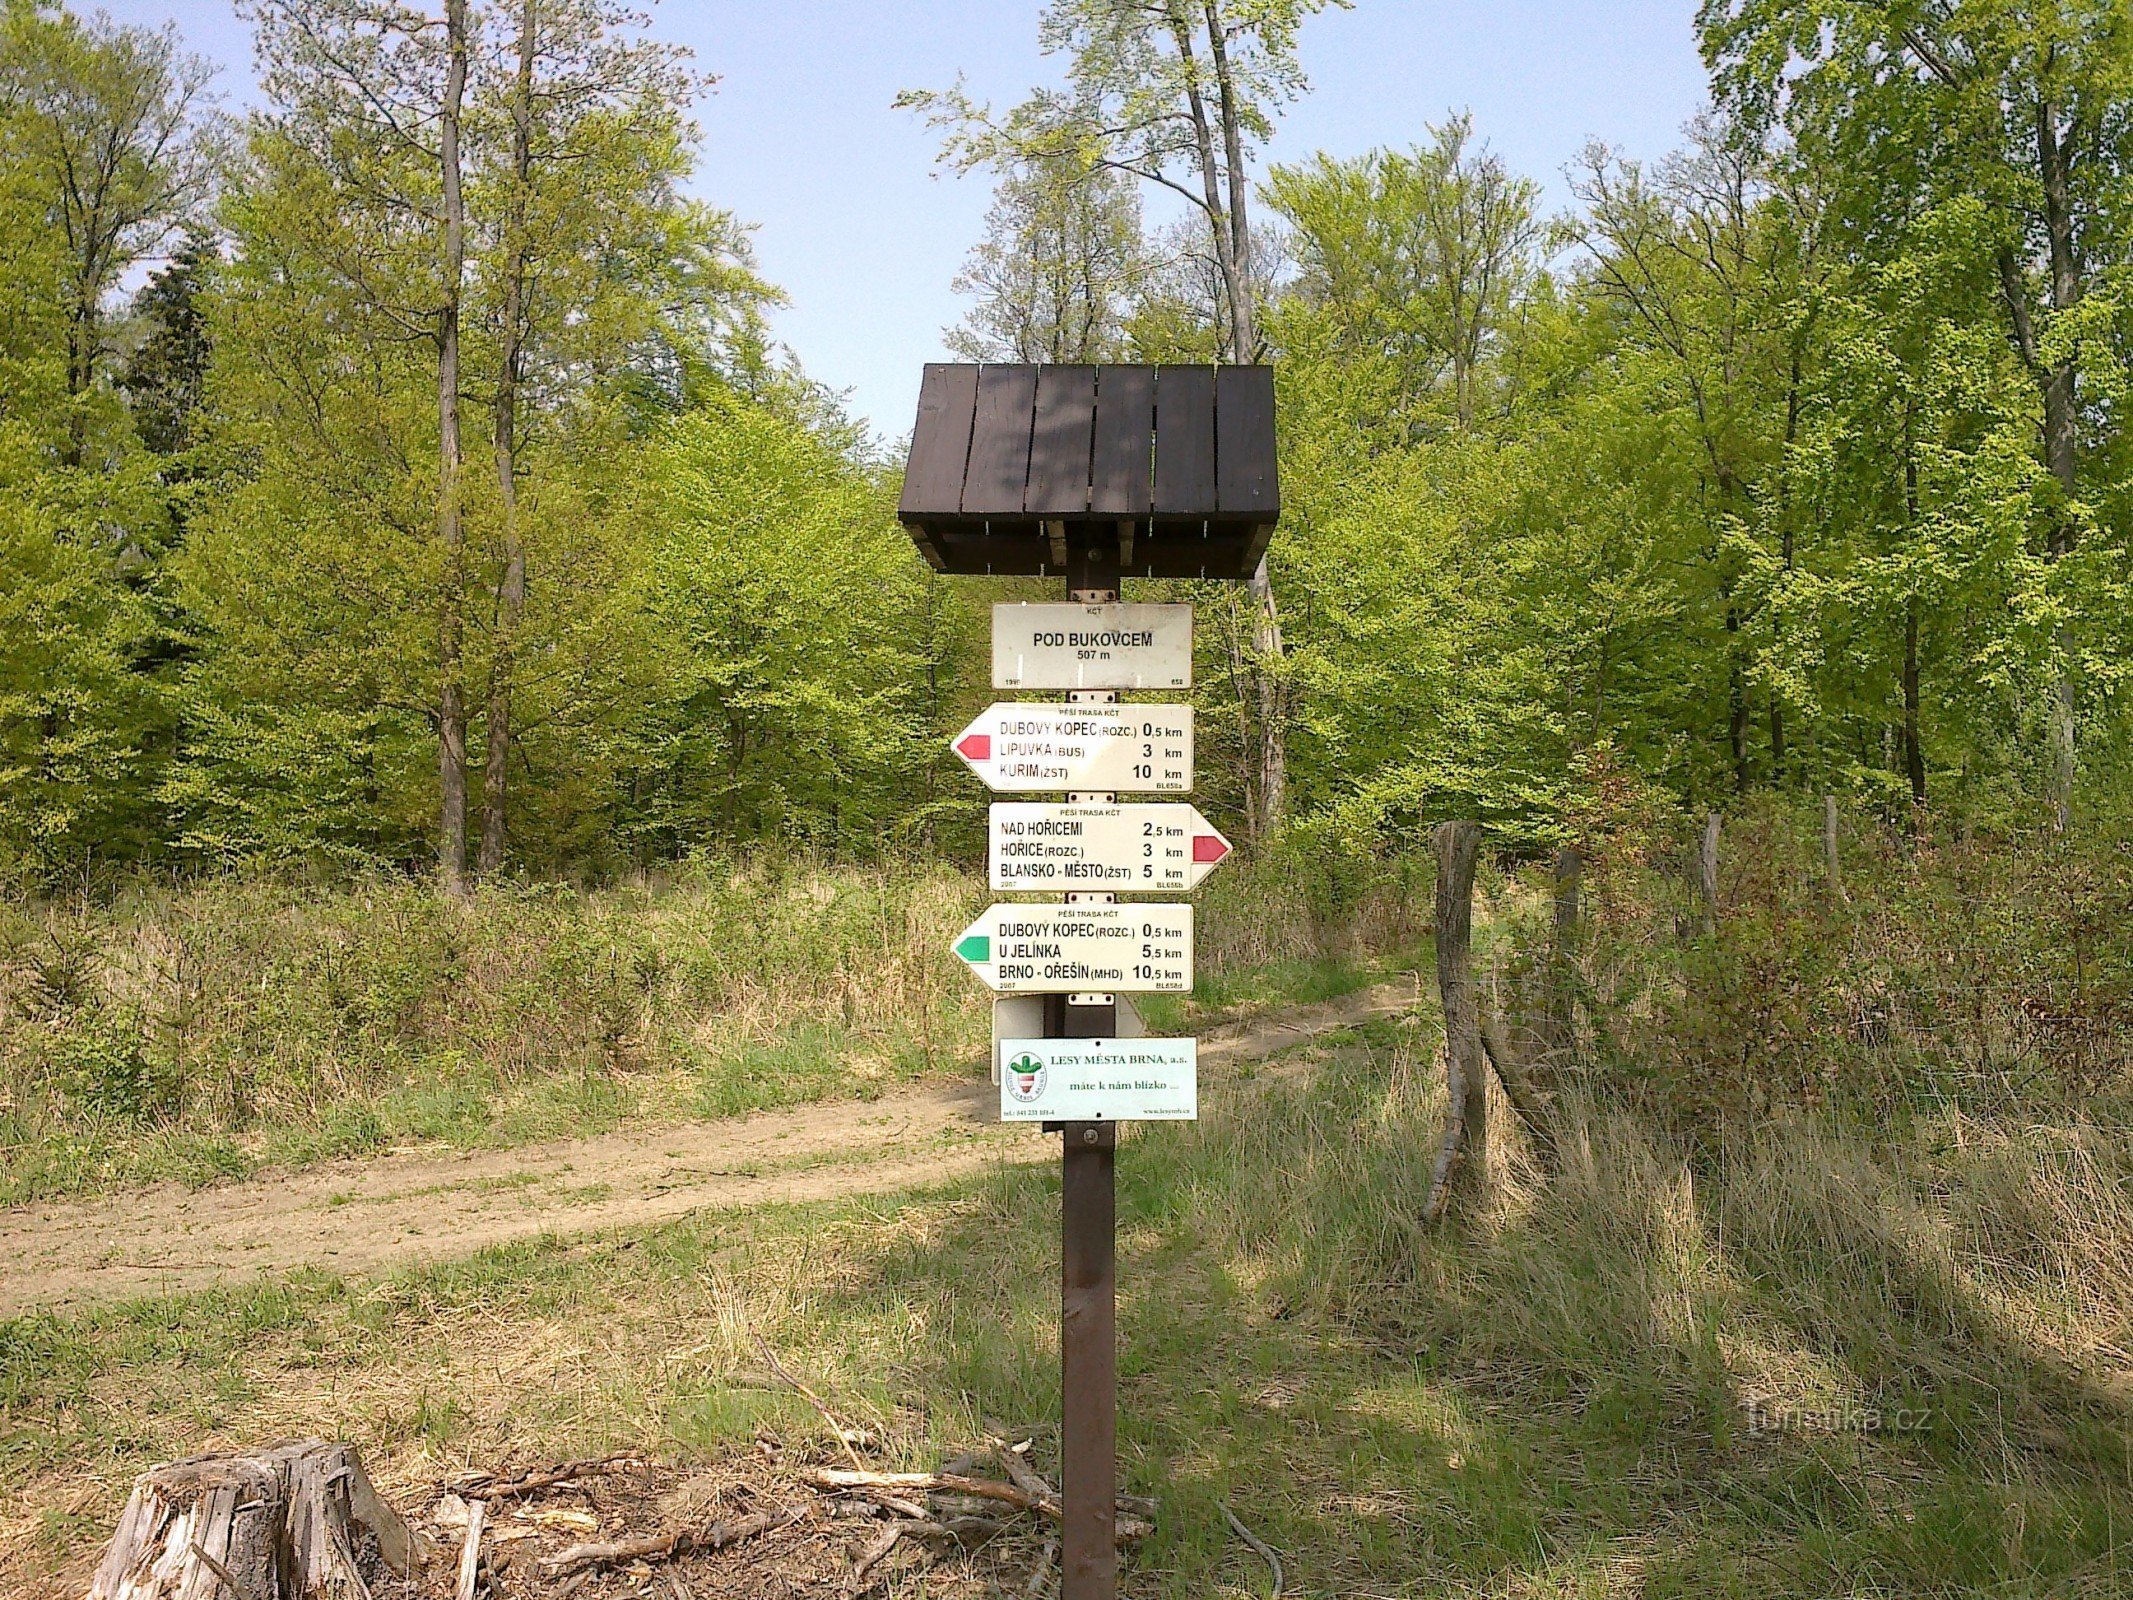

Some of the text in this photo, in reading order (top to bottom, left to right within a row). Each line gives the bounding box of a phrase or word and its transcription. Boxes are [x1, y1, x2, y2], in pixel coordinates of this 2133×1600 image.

[1034, 632, 1152, 647] POD BUKOVCEM
[1078, 650, 1110, 660] 507 m
[1056, 722, 1097, 736] KOPEC
[1143, 723, 1161, 738] 0,5
[1165, 728, 1182, 737] km
[1054, 748, 1085, 758] (BUS)
[1143, 744, 1152, 757] 3
[1165, 749, 1182, 758] km
[1133, 765, 1151, 778] 10
[1165, 769, 1182, 779] km
[1106, 808, 1121, 816] KČT
[1001, 819, 1183, 838] NAD HOŘICEMI 2,5 km
[1001, 839, 1043, 856] HOŘICE
[1143, 844, 1152, 857] 3
[1166, 848, 1183, 857] km
[1001, 863, 1054, 877] BLANSKO
[1065, 860, 1103, 877] MĚSTO
[1104, 866, 1131, 880] (ŽST)
[1143, 865, 1152, 878] 5
[1166, 869, 1182, 878] km
[1104, 910, 1118, 918] KČT
[999, 920, 1049, 937] DUBOVÝ
[1053, 923, 1094, 937] KOPEC
[1143, 923, 1161, 938] 0,5
[1165, 928, 1182, 937] km
[1000, 941, 1182, 959] U JELÍNKA 5,5 km
[1000, 965, 1034, 978] BRNO
[1044, 962, 1088, 978] OŘEŠÍN
[1090, 969, 1123, 980] (MHD)
[1132, 965, 1161, 980] 10,5
[1165, 970, 1182, 979] km
[1051, 1056, 1082, 1065] LESY
[1084, 1053, 1126, 1065] MĚSTA
[1129, 1055, 1167, 1065] BRNA,
[1070, 1082, 1095, 1090] máte
[1099, 1081, 1106, 1090] k
[1108, 1081, 1132, 1090] nám
[1134, 1081, 1166, 1090] blízko
